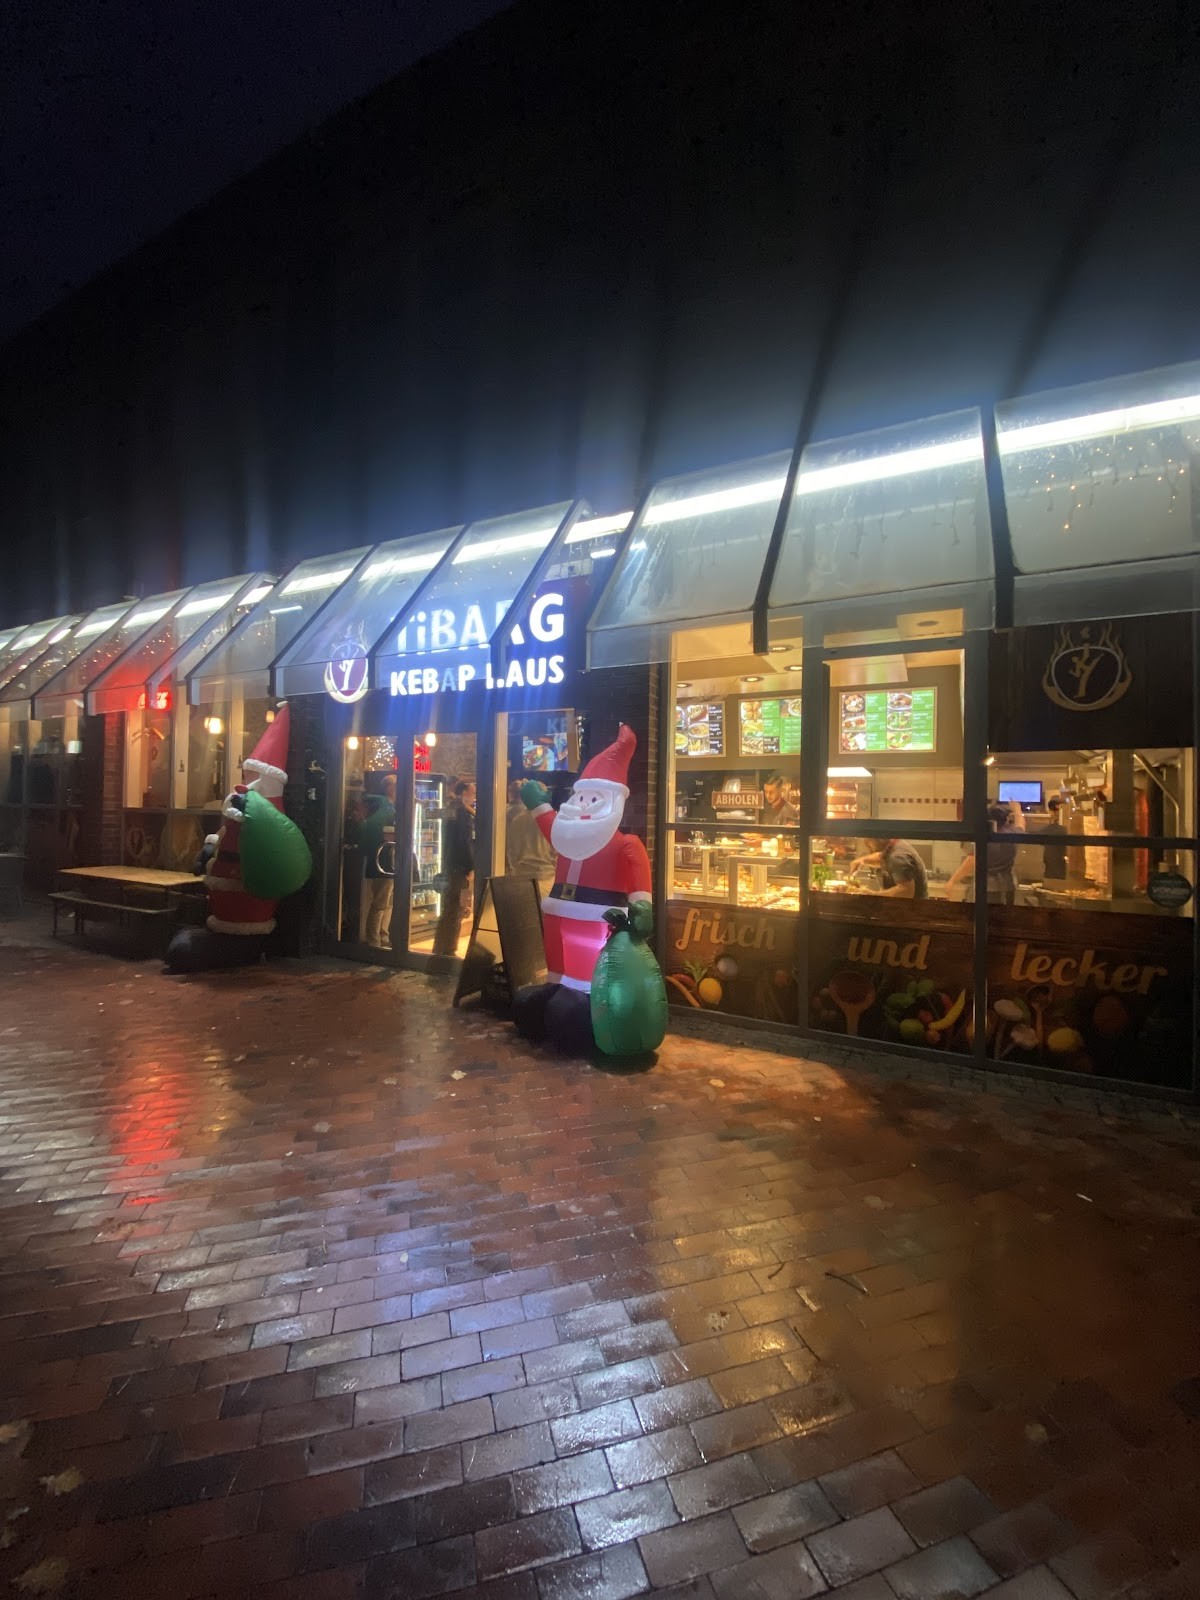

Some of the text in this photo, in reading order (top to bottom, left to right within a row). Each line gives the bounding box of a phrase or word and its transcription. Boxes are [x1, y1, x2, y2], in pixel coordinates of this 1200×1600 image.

[390, 664, 476, 696] KEBAP
[716, 794, 759, 805] ABHOLEN
[675, 908, 1169, 995] frisch und lecker
